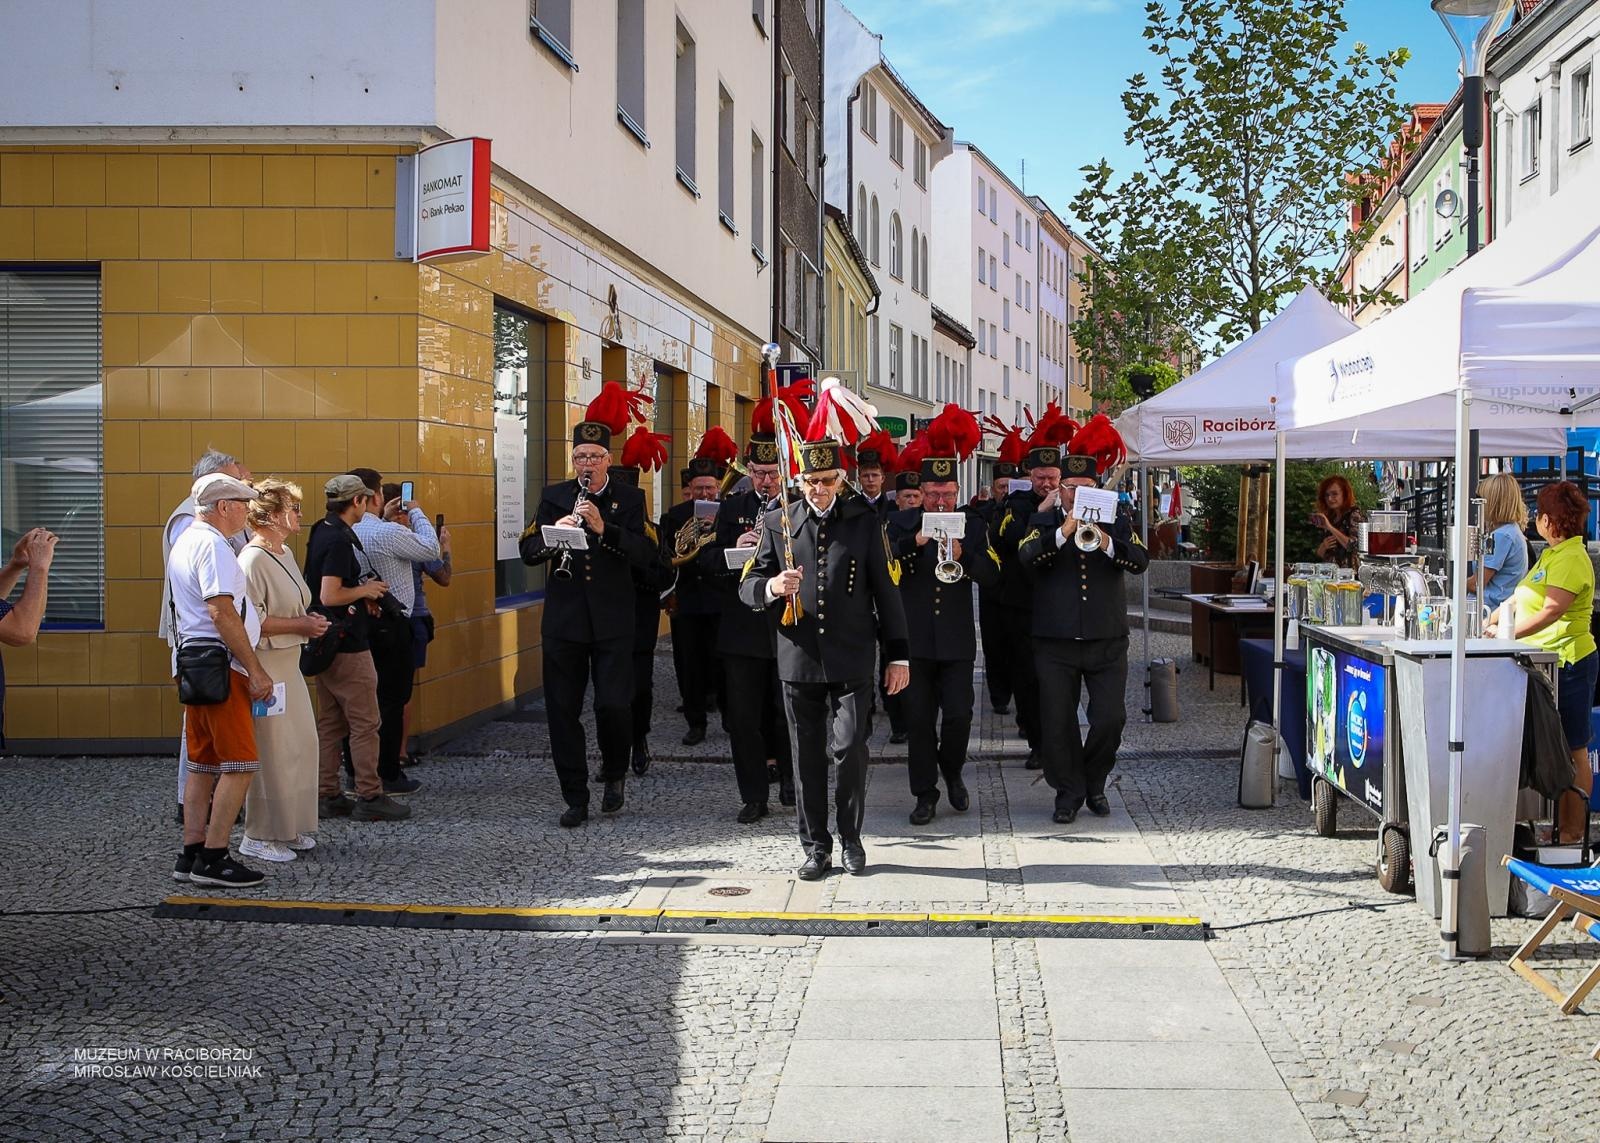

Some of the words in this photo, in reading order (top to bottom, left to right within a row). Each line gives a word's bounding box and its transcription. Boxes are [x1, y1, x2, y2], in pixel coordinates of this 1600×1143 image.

[423, 175, 463, 194] BANKOMAT
[430, 206, 443, 218] Bank
[444, 203, 465, 215] Pekao
[1202, 417, 1276, 432] Racibórz
[1203, 436, 1223, 446] 1217
